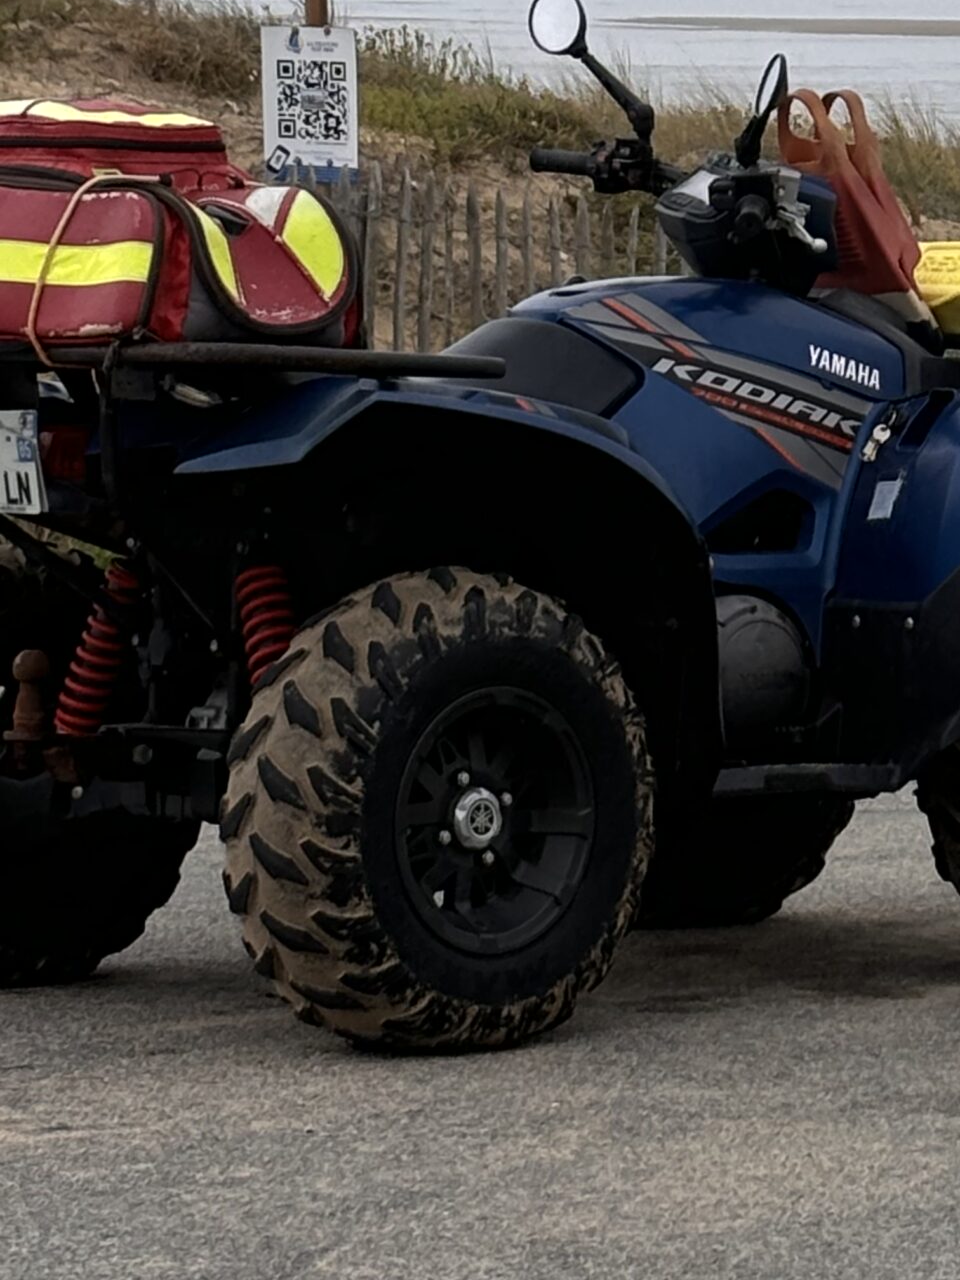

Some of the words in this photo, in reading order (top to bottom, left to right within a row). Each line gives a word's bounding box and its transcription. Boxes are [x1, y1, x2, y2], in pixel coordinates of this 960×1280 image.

[808, 344, 881, 391] YAMAHA
[651, 357, 863, 437] KODIAK
[3, 470, 32, 505] LN
